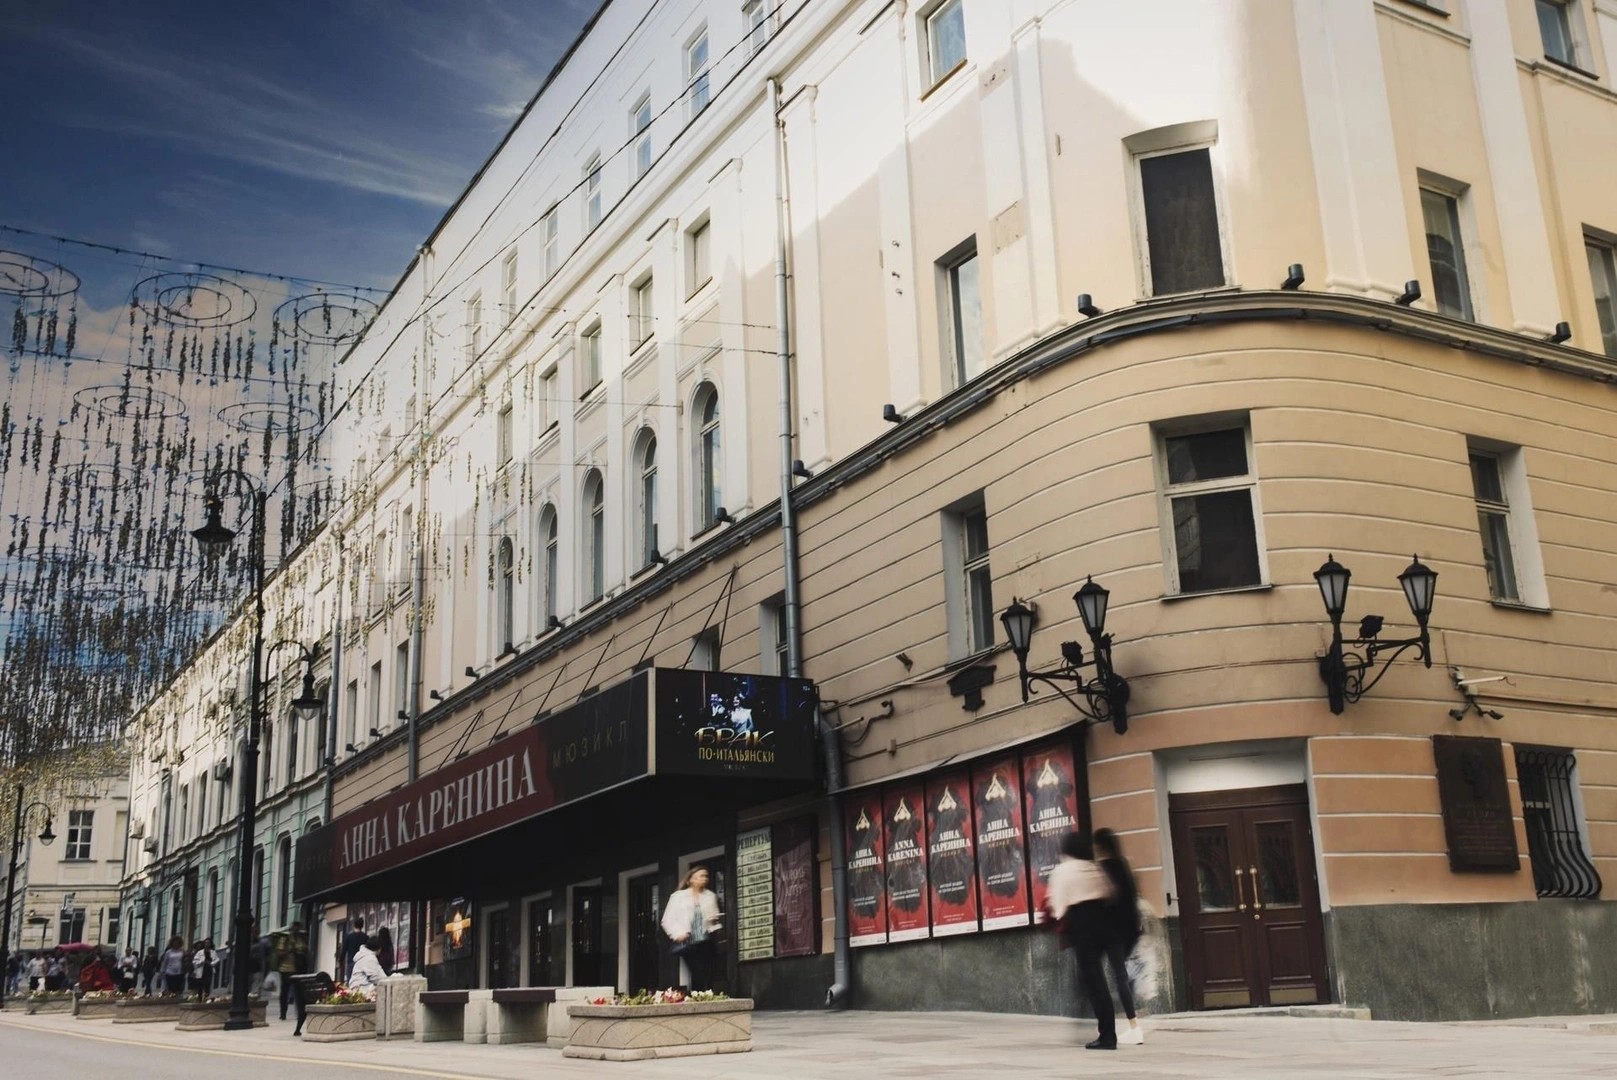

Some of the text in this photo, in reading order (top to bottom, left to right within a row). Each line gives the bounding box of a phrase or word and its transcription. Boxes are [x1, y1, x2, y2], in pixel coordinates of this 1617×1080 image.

[552, 720, 627, 769] МЮЗИКЛ
[694, 726, 775, 749] БРАК
[698, 747, 775, 764] ПО-ИТАЛЬЯНСКИ
[340, 746, 538, 870] АННА КАРЕНИНА
[1038, 806, 1063, 820] АННА
[986, 818, 1008, 832] АННА
[1030, 815, 1076, 834] КАРЕНИНА
[979, 826, 1020, 844] КАРЕНИНА
[894, 838, 914, 851] ANNA
[931, 838, 971, 853] КАРЕНИНА
[887, 847, 924, 862] KARENINA
